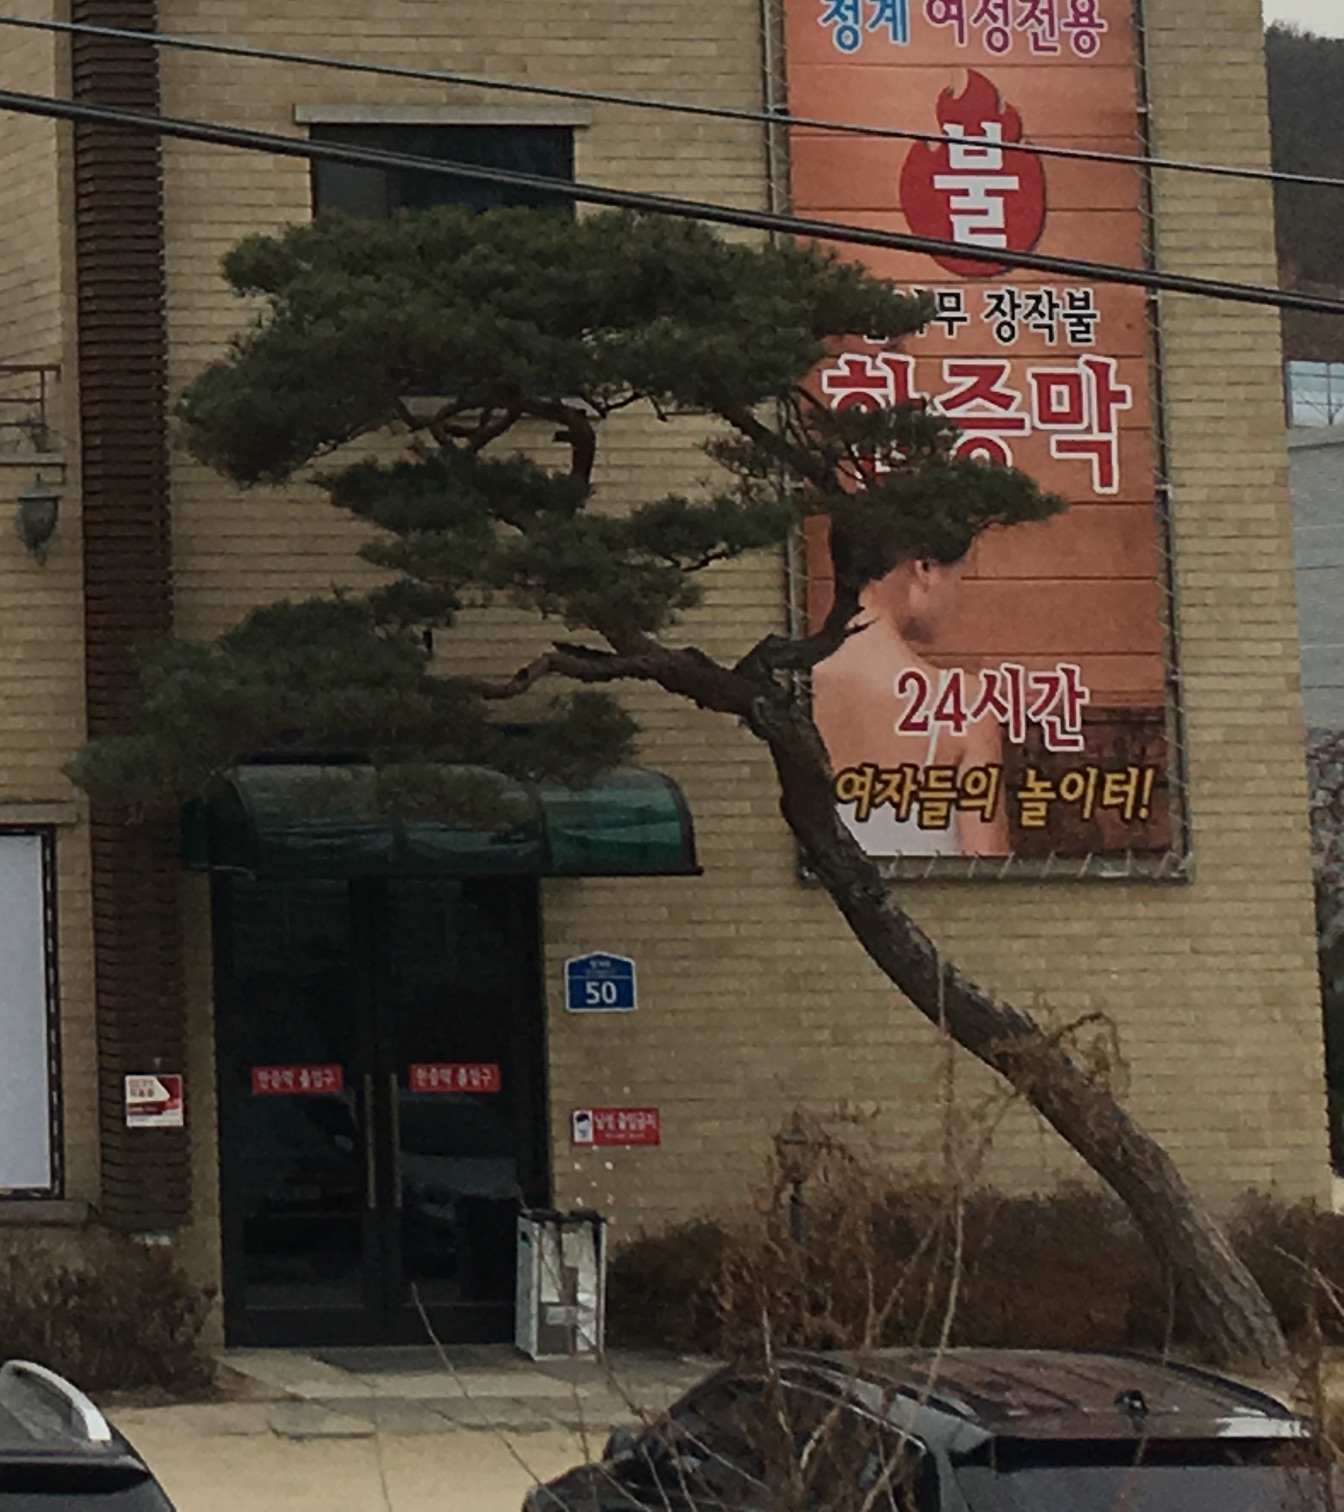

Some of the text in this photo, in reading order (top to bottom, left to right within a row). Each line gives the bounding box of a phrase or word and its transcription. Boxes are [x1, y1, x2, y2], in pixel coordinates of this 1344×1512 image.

[933, 121, 1020, 249] 불
[983, 288, 1100, 344] 장작불
[895, 663, 1090, 751] 24시간
[834, 764, 1155, 829] 여자들의 놀이터!
[585, 981, 618, 1004] 50
